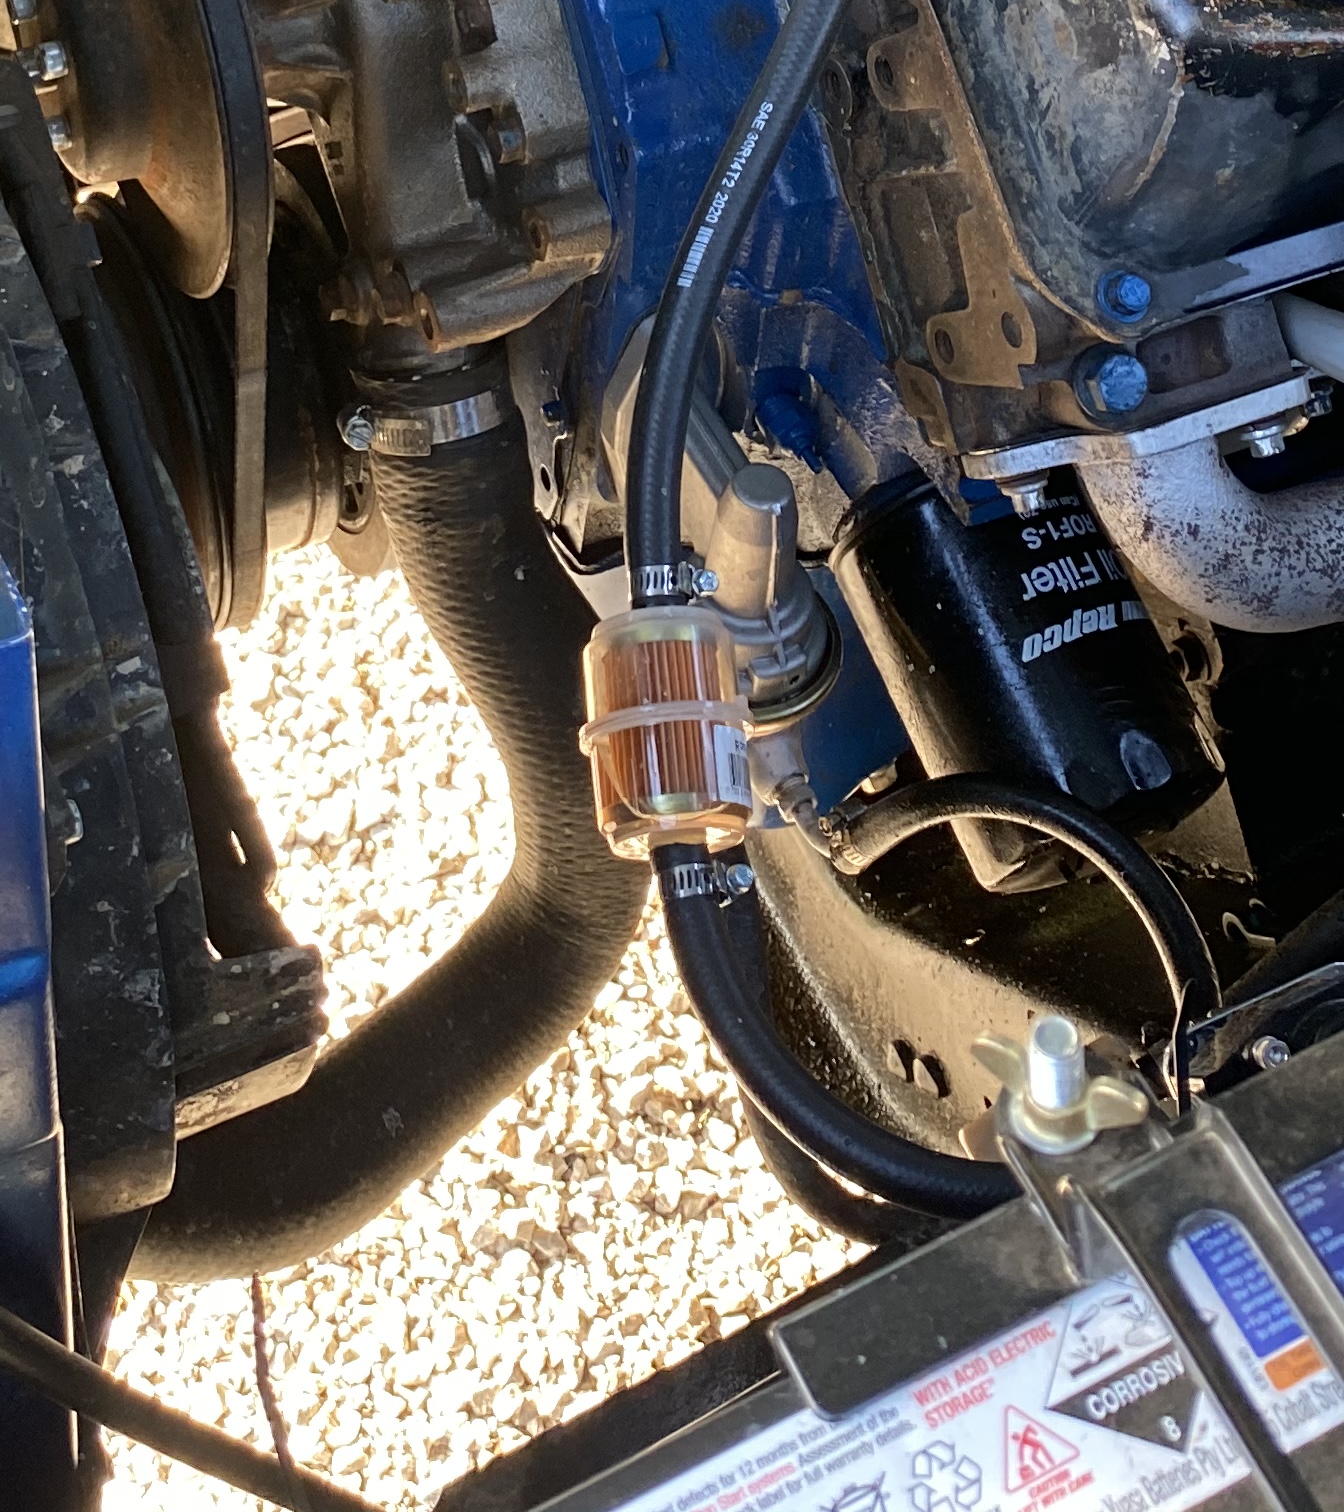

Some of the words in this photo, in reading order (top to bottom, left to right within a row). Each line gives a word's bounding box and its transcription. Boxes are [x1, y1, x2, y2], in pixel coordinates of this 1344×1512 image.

[751, 101, 774, 132] SAE
[721, 131, 759, 189] 30R14T2
[706, 191, 729, 224] 2020
[1022, 513, 1097, 549] ROF1-S
[1020, 551, 1103, 602] Filter
[1097, 548, 1129, 581] Oil
[1021, 603, 1119, 663] Repco
[912, 1375, 953, 1407] WITH
[953, 1356, 990, 1387] ACID
[988, 1320, 1056, 1368] ELECTRIC
[1084, 1350, 1186, 1421] CORROSIV
[798, 1421, 867, 1468] Assessment
[1162, 1415, 1182, 1443] 8
[1215, 1432, 1241, 1465] Lt
[719, 1470, 737, 1488] for
[738, 1459, 757, 1479] 12
[756, 1439, 799, 1470] months
[798, 1423, 827, 1446] from
[803, 1464, 825, 1485] full
[823, 1441, 876, 1474] warranty
